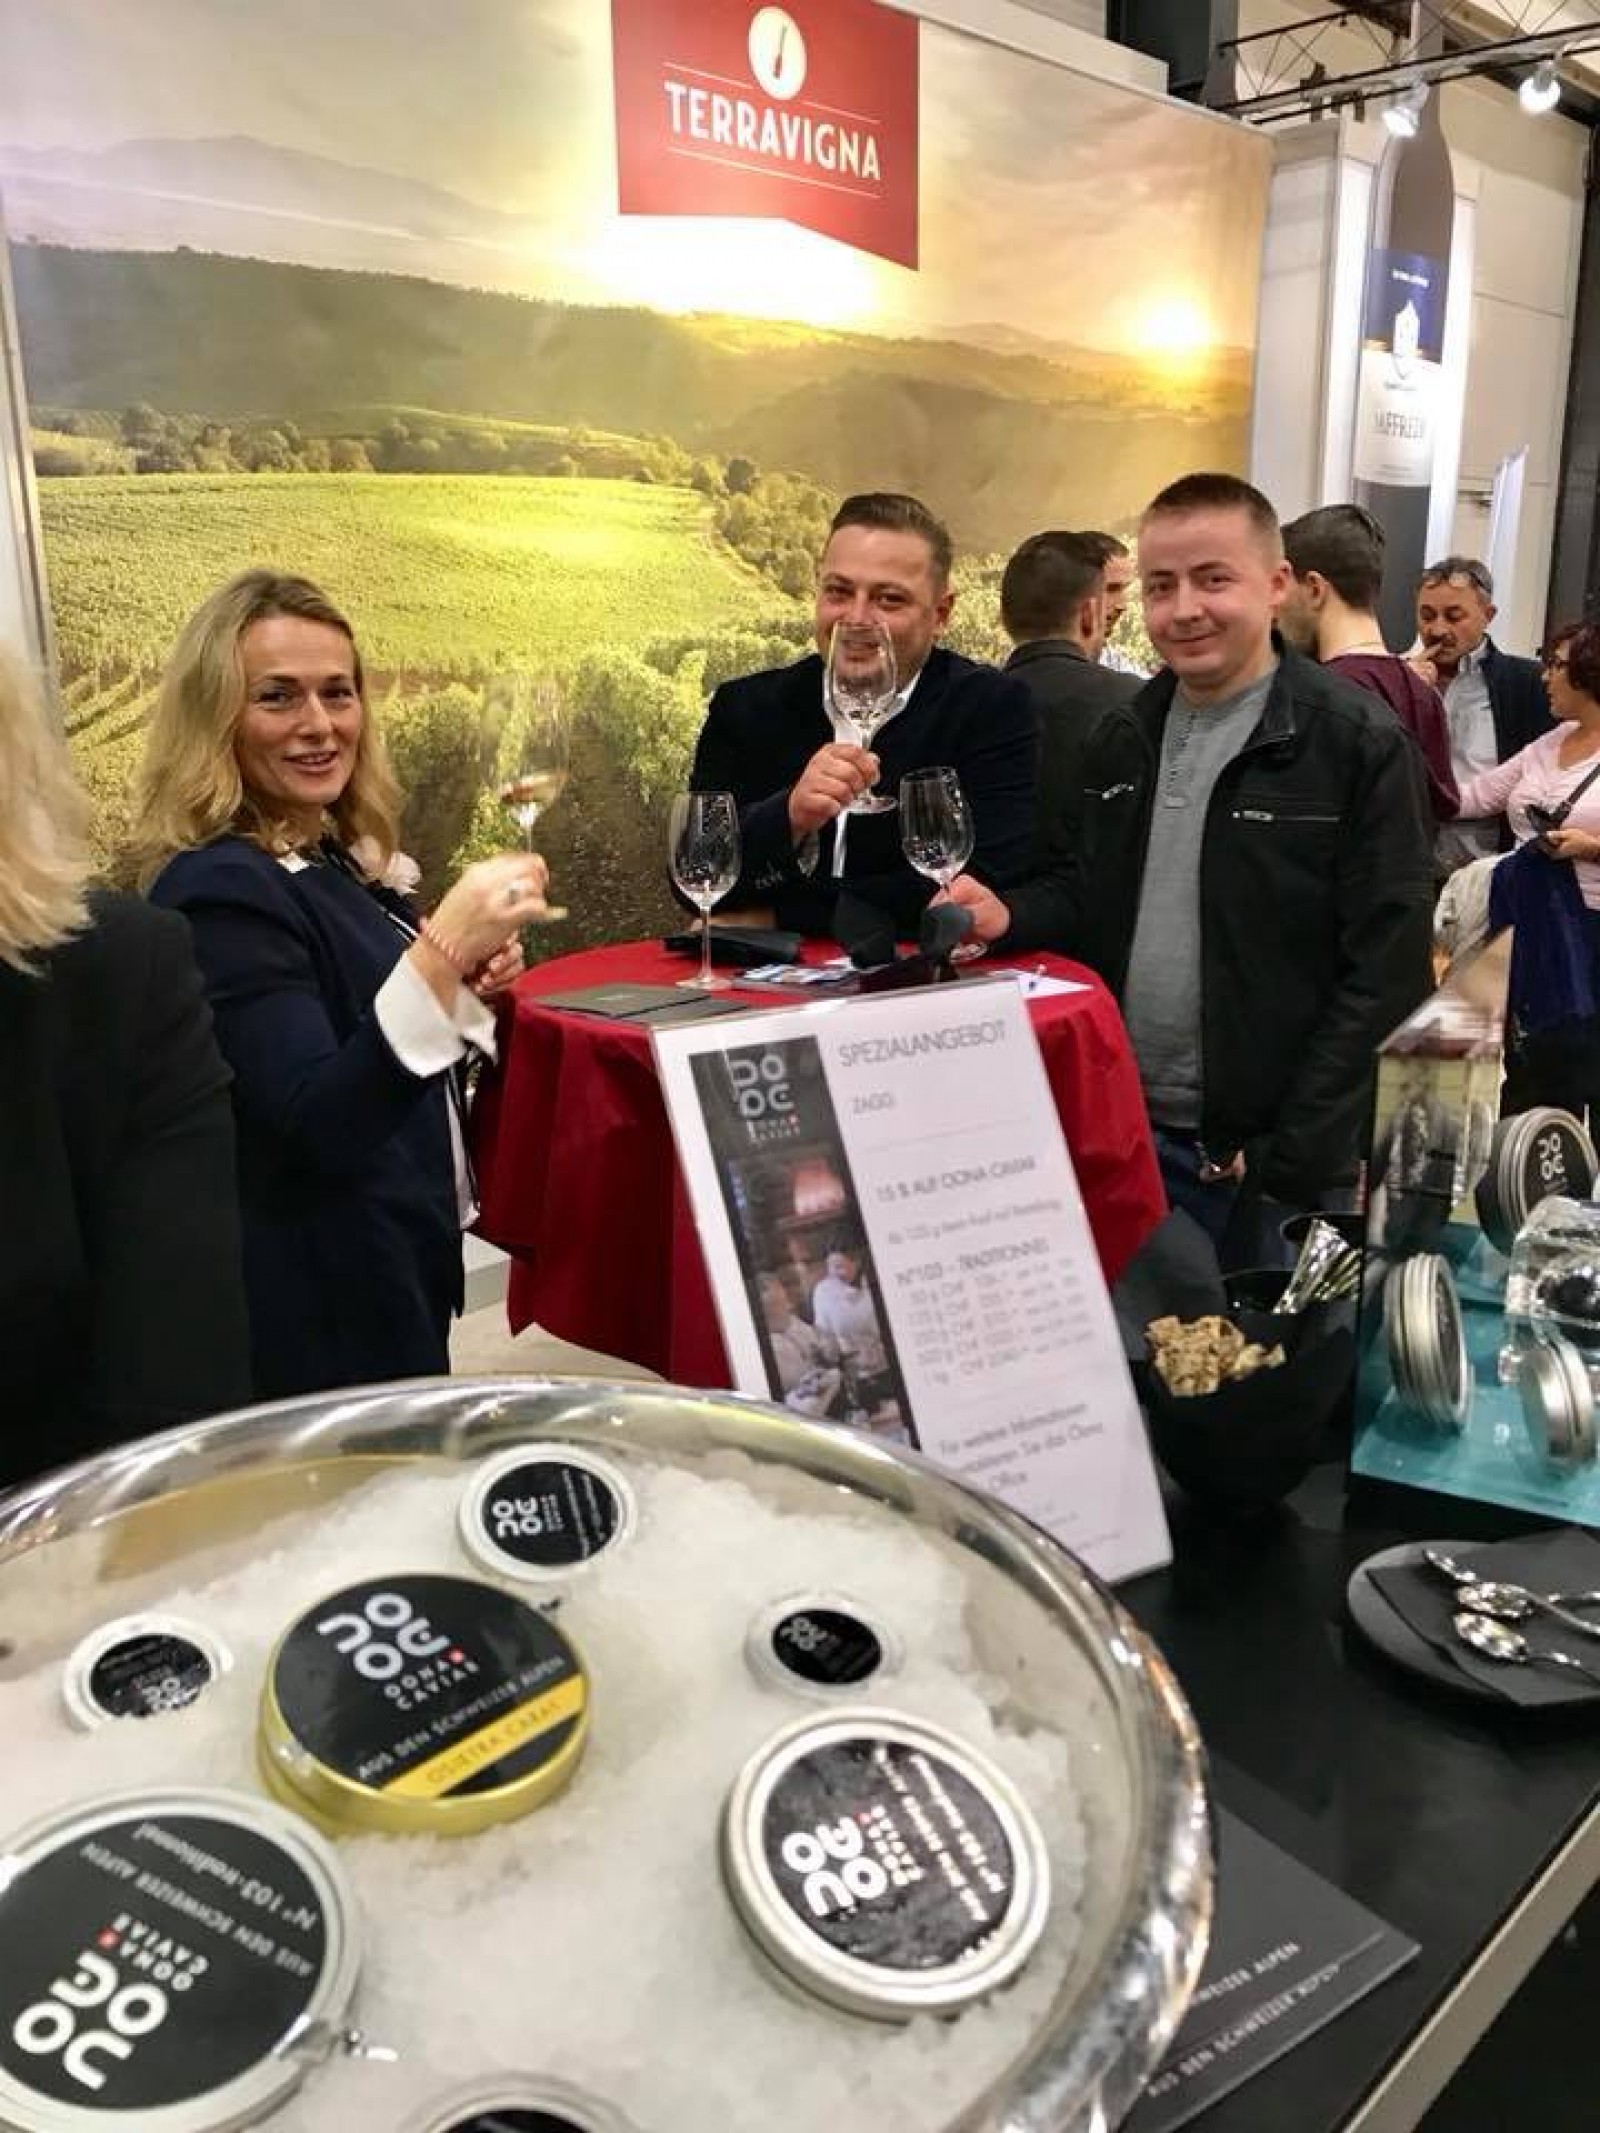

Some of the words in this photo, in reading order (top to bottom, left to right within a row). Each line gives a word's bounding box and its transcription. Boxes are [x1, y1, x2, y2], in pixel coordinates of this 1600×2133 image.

[663, 80, 881, 181] TERRAVIGNA
[838, 1019, 1006, 1068] SPEZIALANGEBOT
[397, 1660, 480, 1710] CAVIAR
[111, 1913, 210, 1975] CAVIAR
[119, 1940, 194, 1992] OONA
